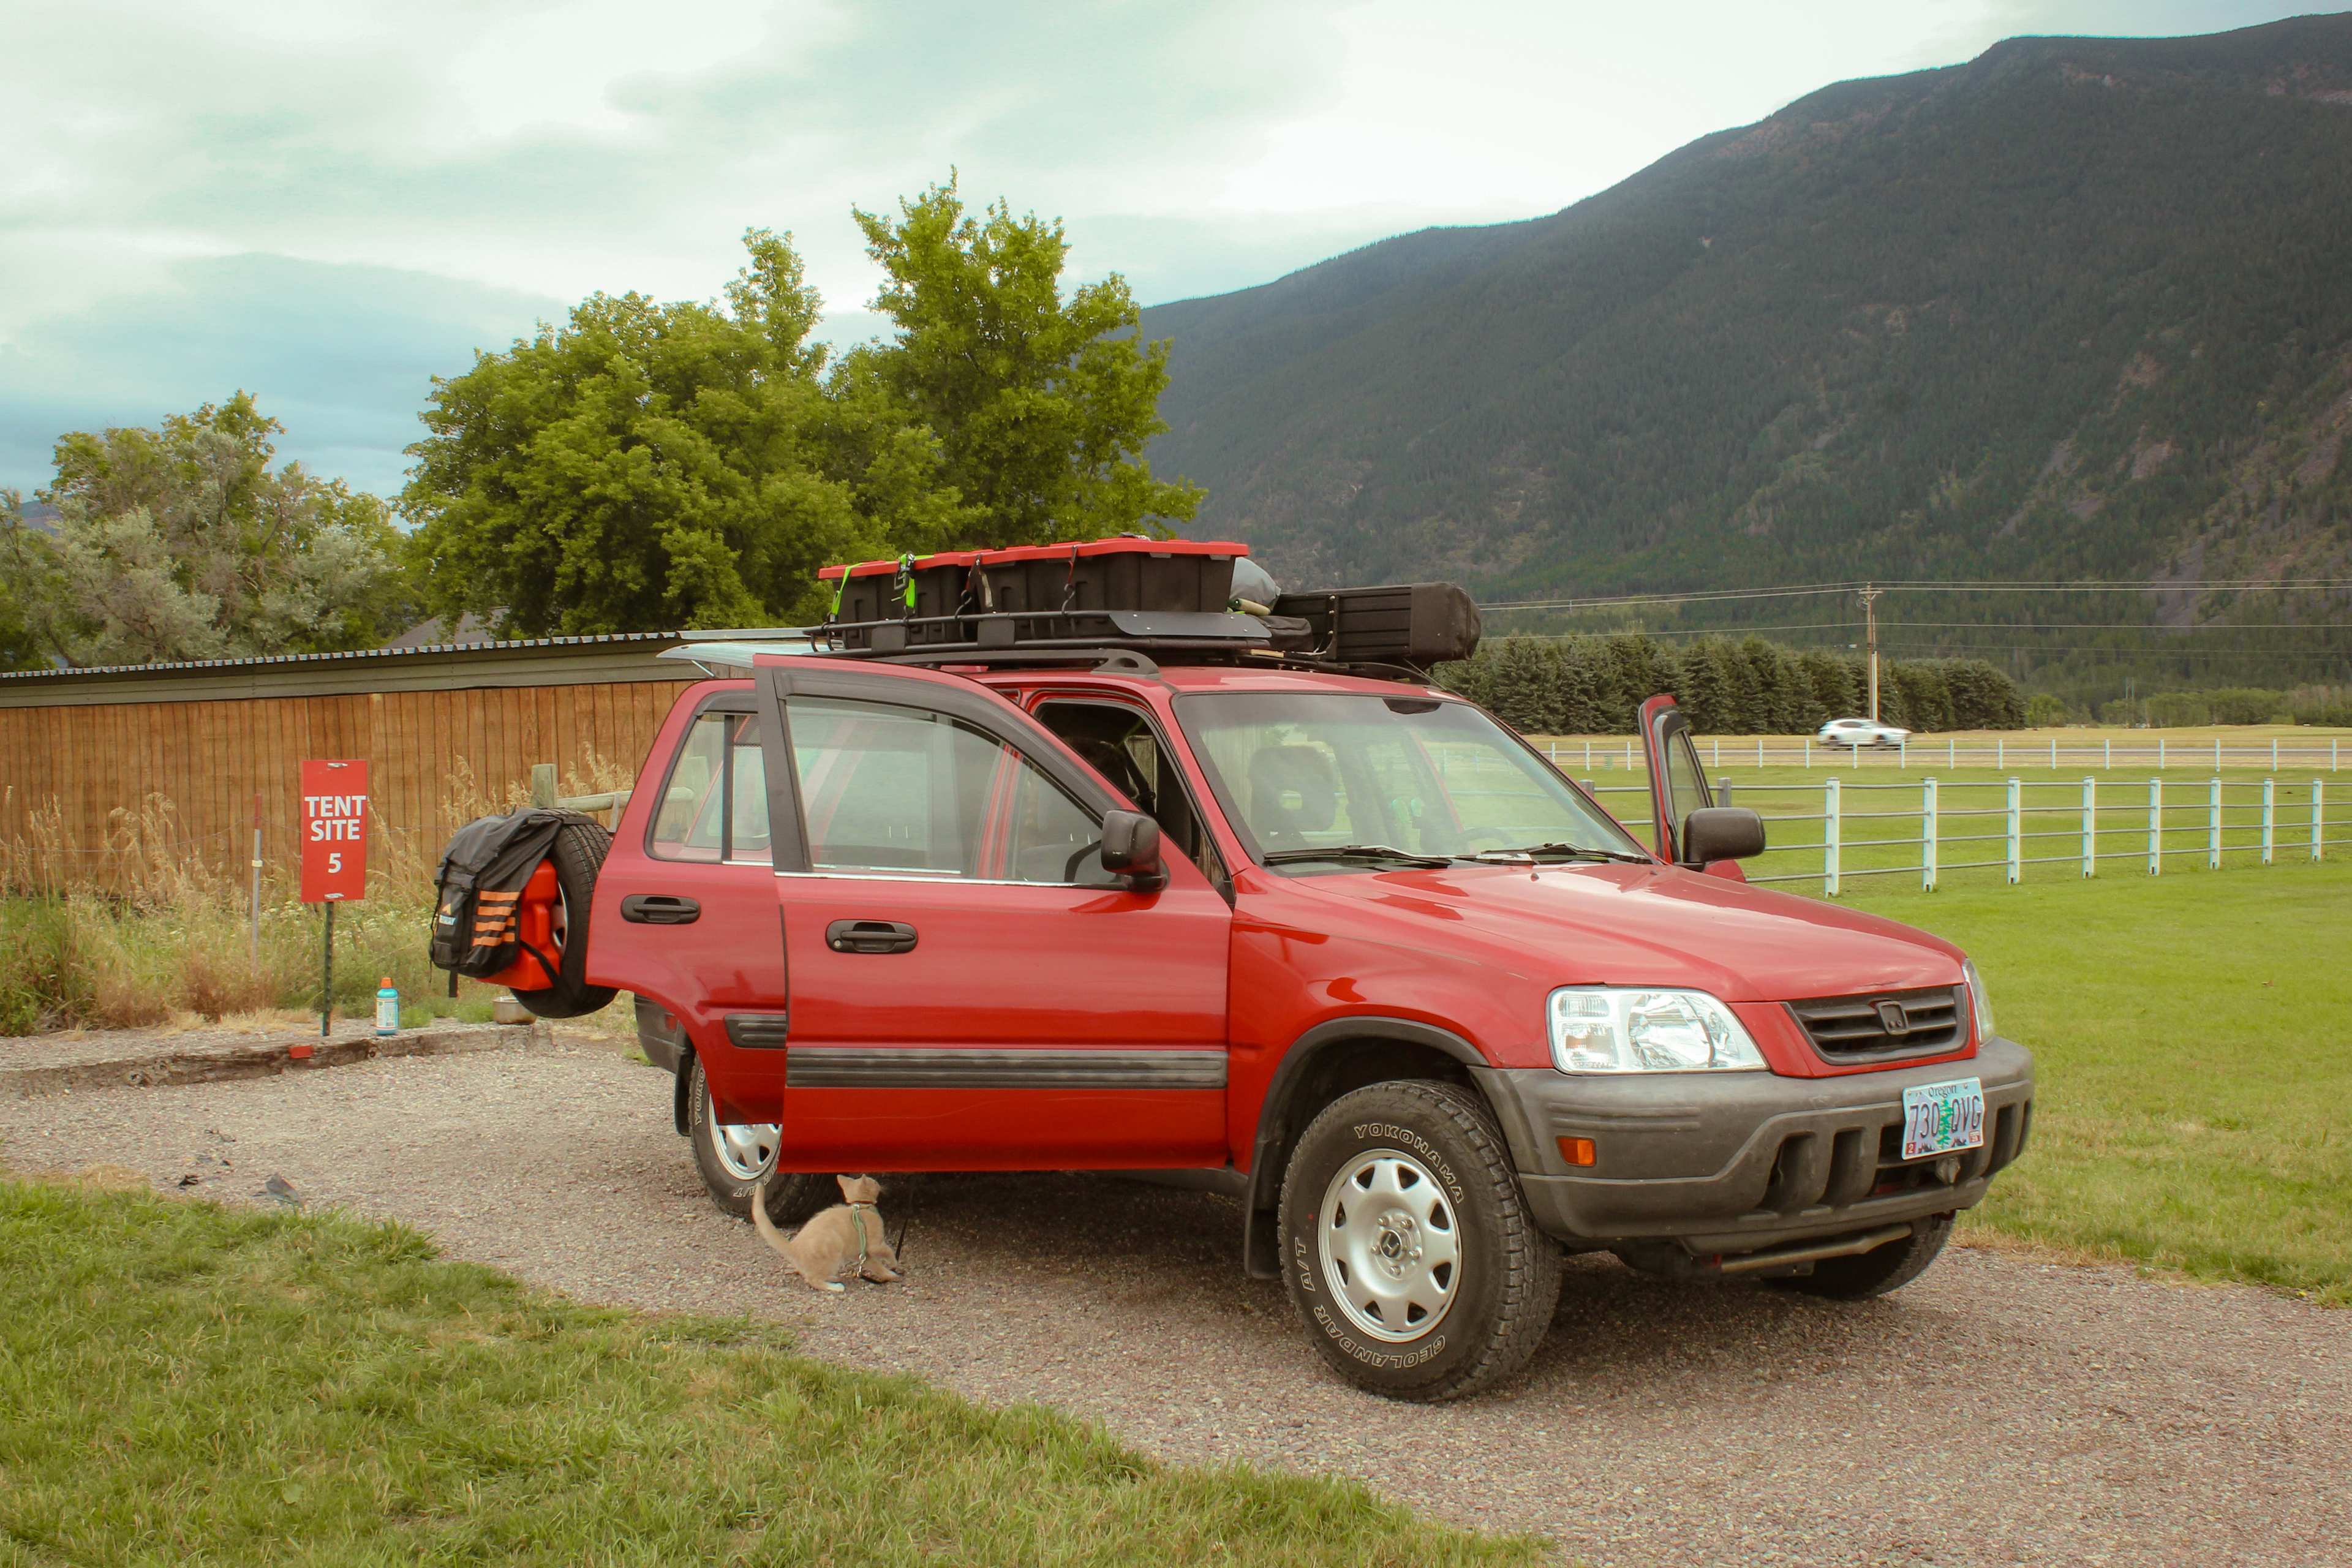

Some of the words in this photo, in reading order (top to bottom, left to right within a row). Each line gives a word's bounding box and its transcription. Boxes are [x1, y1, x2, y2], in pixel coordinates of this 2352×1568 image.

[304, 795, 366, 817] TENT
[311, 820, 360, 841] SITE
[328, 853, 342, 873] 5
[694, 1068, 706, 1126] YOKO
[1928, 1085, 1957, 1098] Oregon
[1910, 1102, 1940, 1140] 730
[1353, 1123, 1464, 1204] YOKOHAMA
[1908, 1144, 1914, 1154] 2
[1295, 1237, 1316, 1292] A/T
[1314, 1305, 1446, 1368] GEOLANDAR
